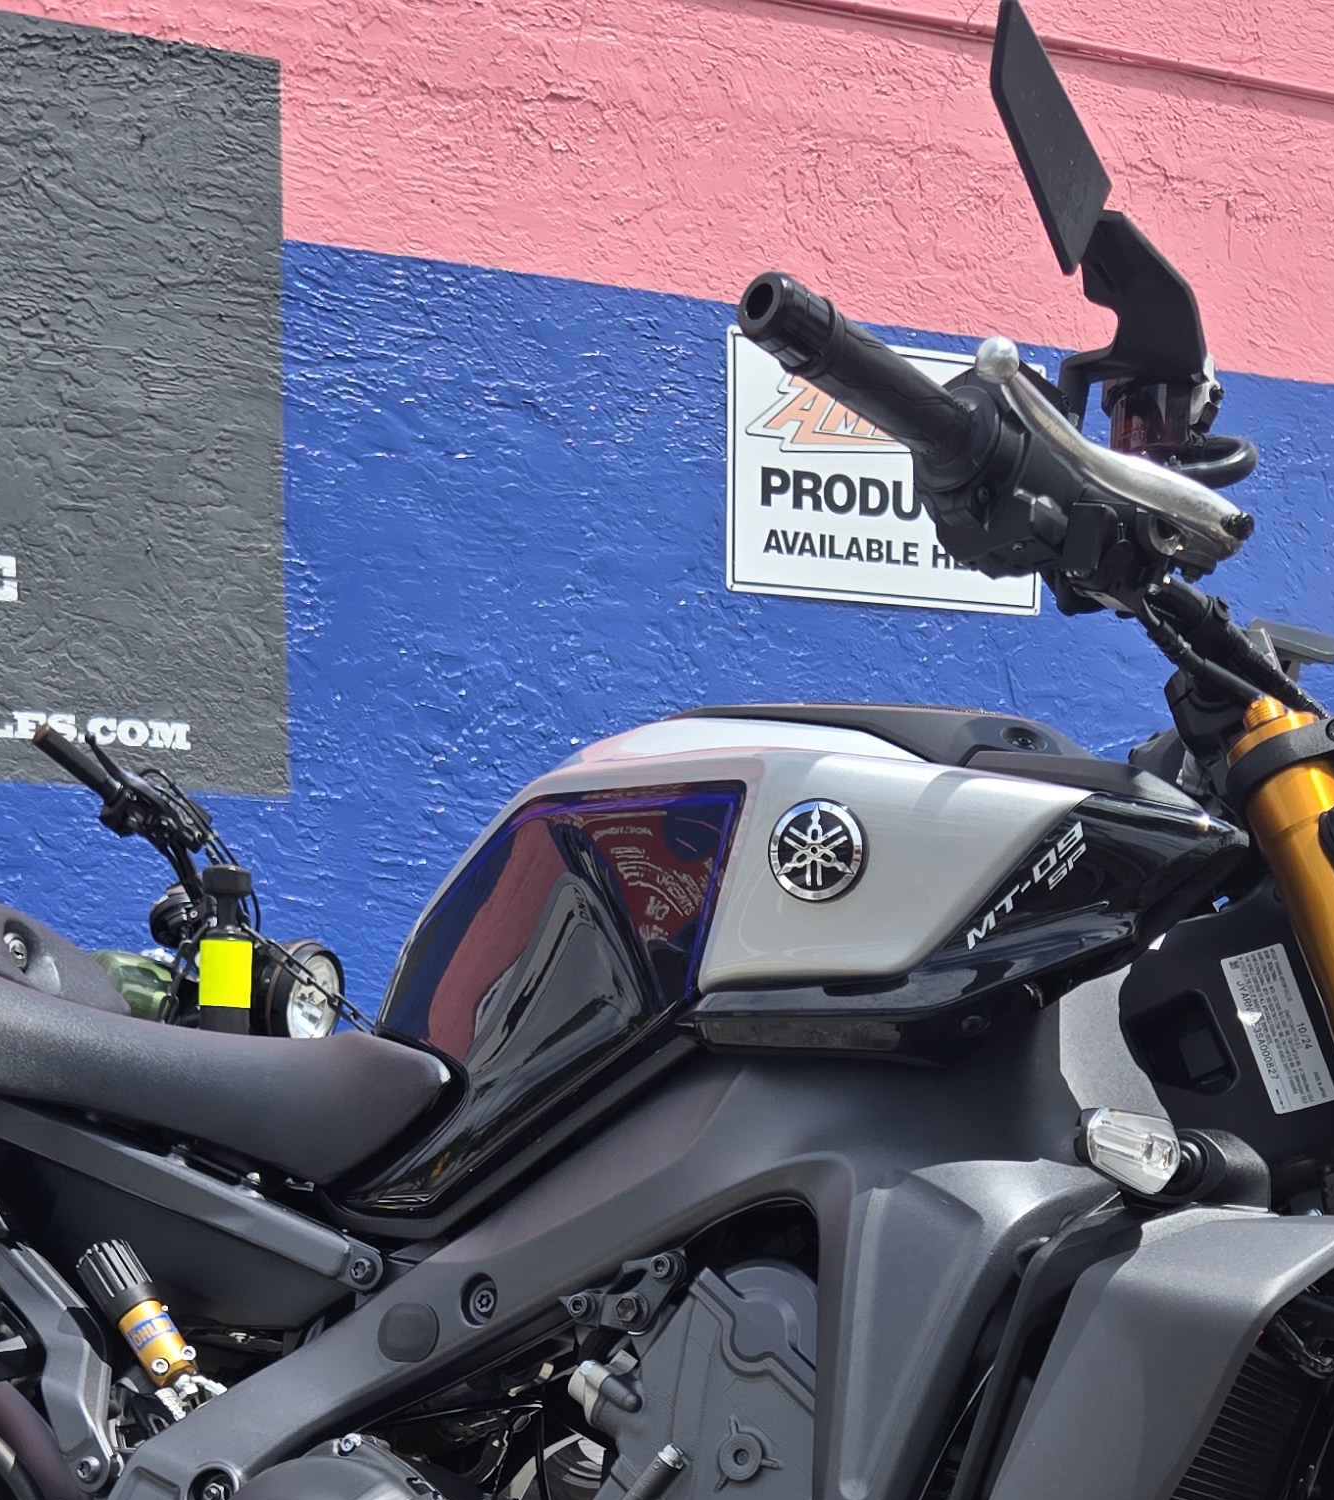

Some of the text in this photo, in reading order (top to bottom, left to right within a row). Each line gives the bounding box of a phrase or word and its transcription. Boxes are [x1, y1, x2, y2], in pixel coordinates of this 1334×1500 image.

[761, 466, 922, 521] PRODU
[763, 528, 919, 568] AVAILABLE
[966, 820, 1084, 950] MT-09
[1048, 843, 1087, 890] SP
[1296, 1022, 1313, 1050] 10/24
